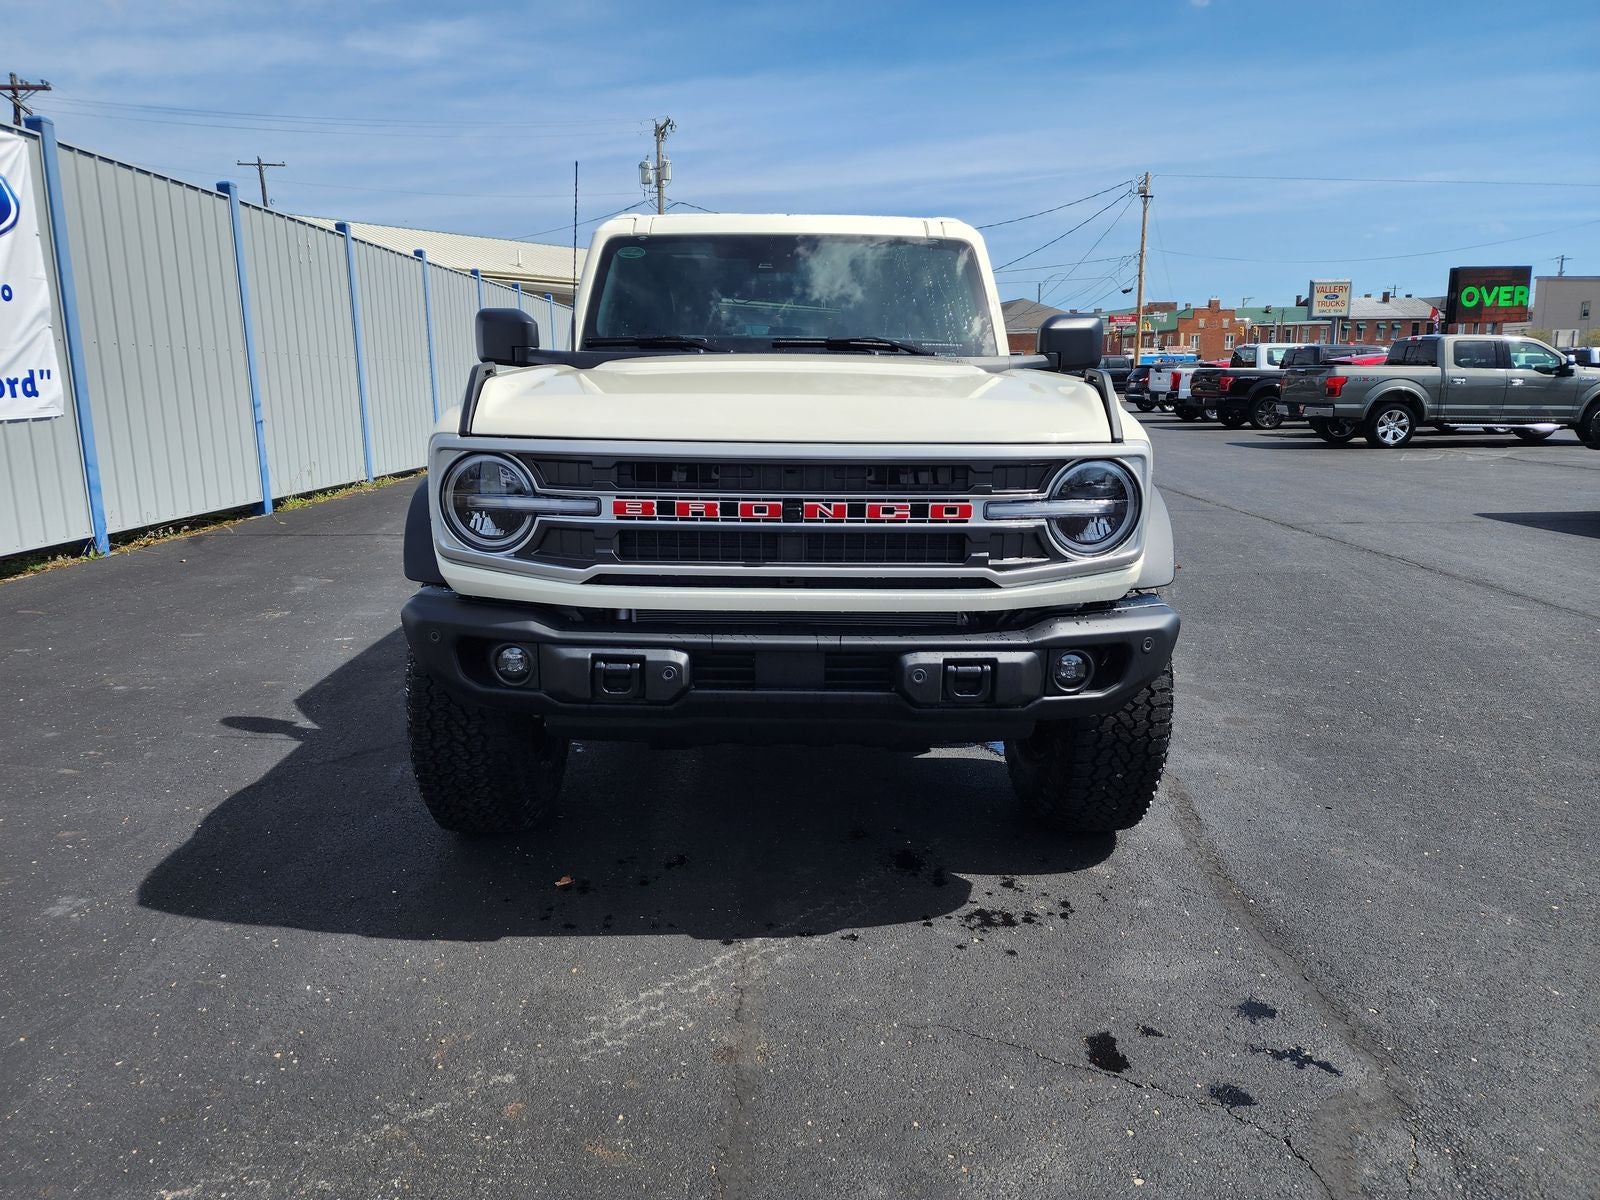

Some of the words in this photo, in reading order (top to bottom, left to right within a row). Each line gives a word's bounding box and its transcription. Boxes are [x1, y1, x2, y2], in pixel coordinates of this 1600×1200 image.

[1316, 286, 1348, 294] VALLERY
[1461, 285, 1529, 308] OVER
[612, 498, 974, 519] BRONCO
